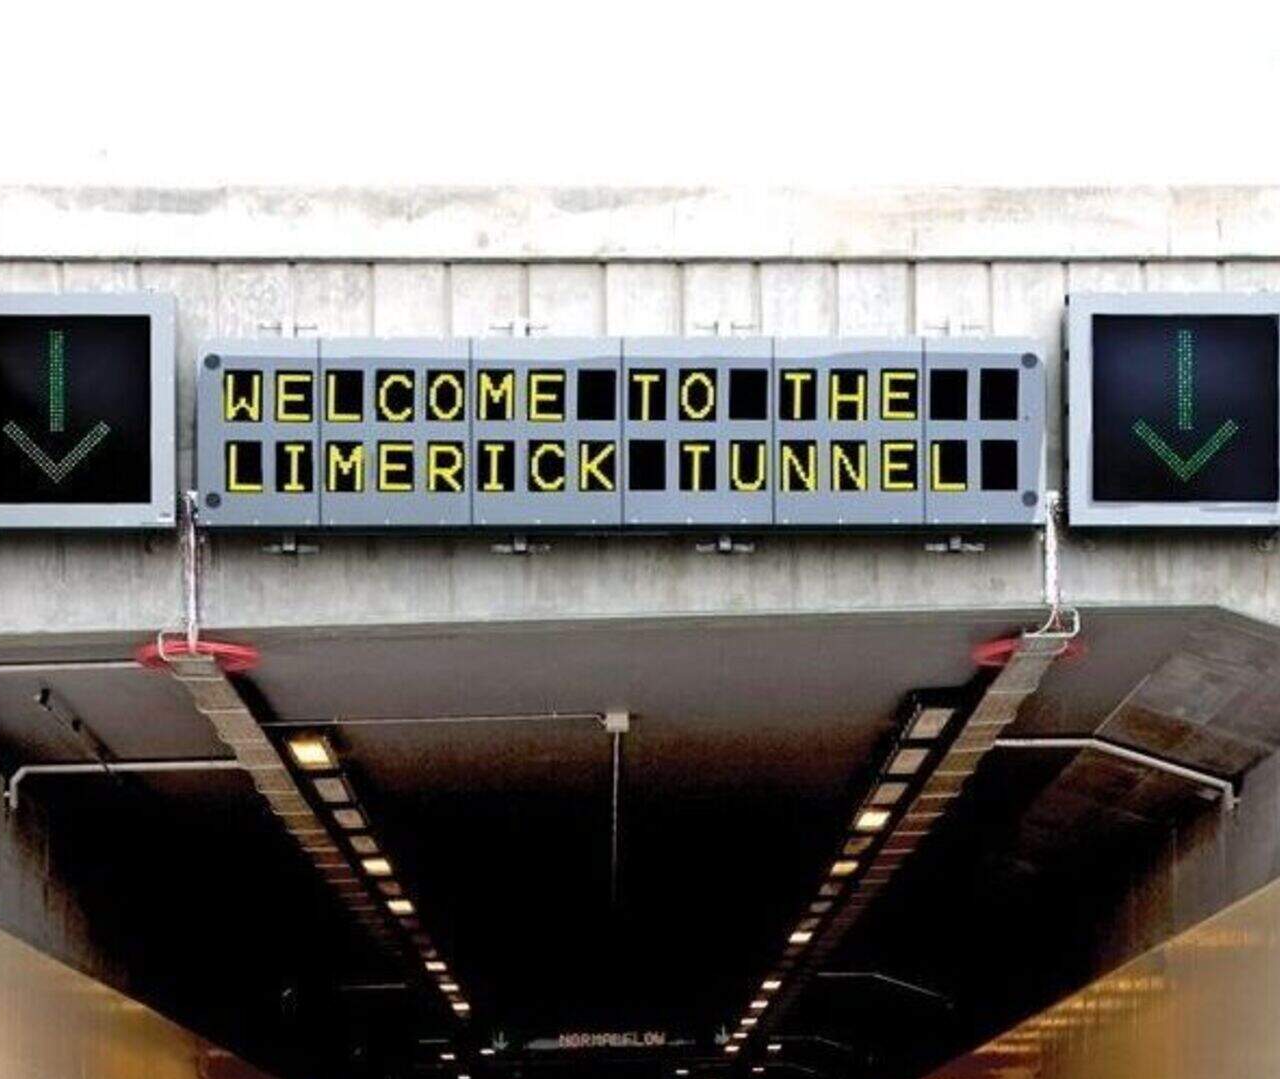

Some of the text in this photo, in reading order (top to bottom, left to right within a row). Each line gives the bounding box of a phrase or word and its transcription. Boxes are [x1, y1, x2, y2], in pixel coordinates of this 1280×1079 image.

[226, 372, 915, 421] WELCOME TO THE
[227, 443, 966, 492] LIMERICK TUNNEL
